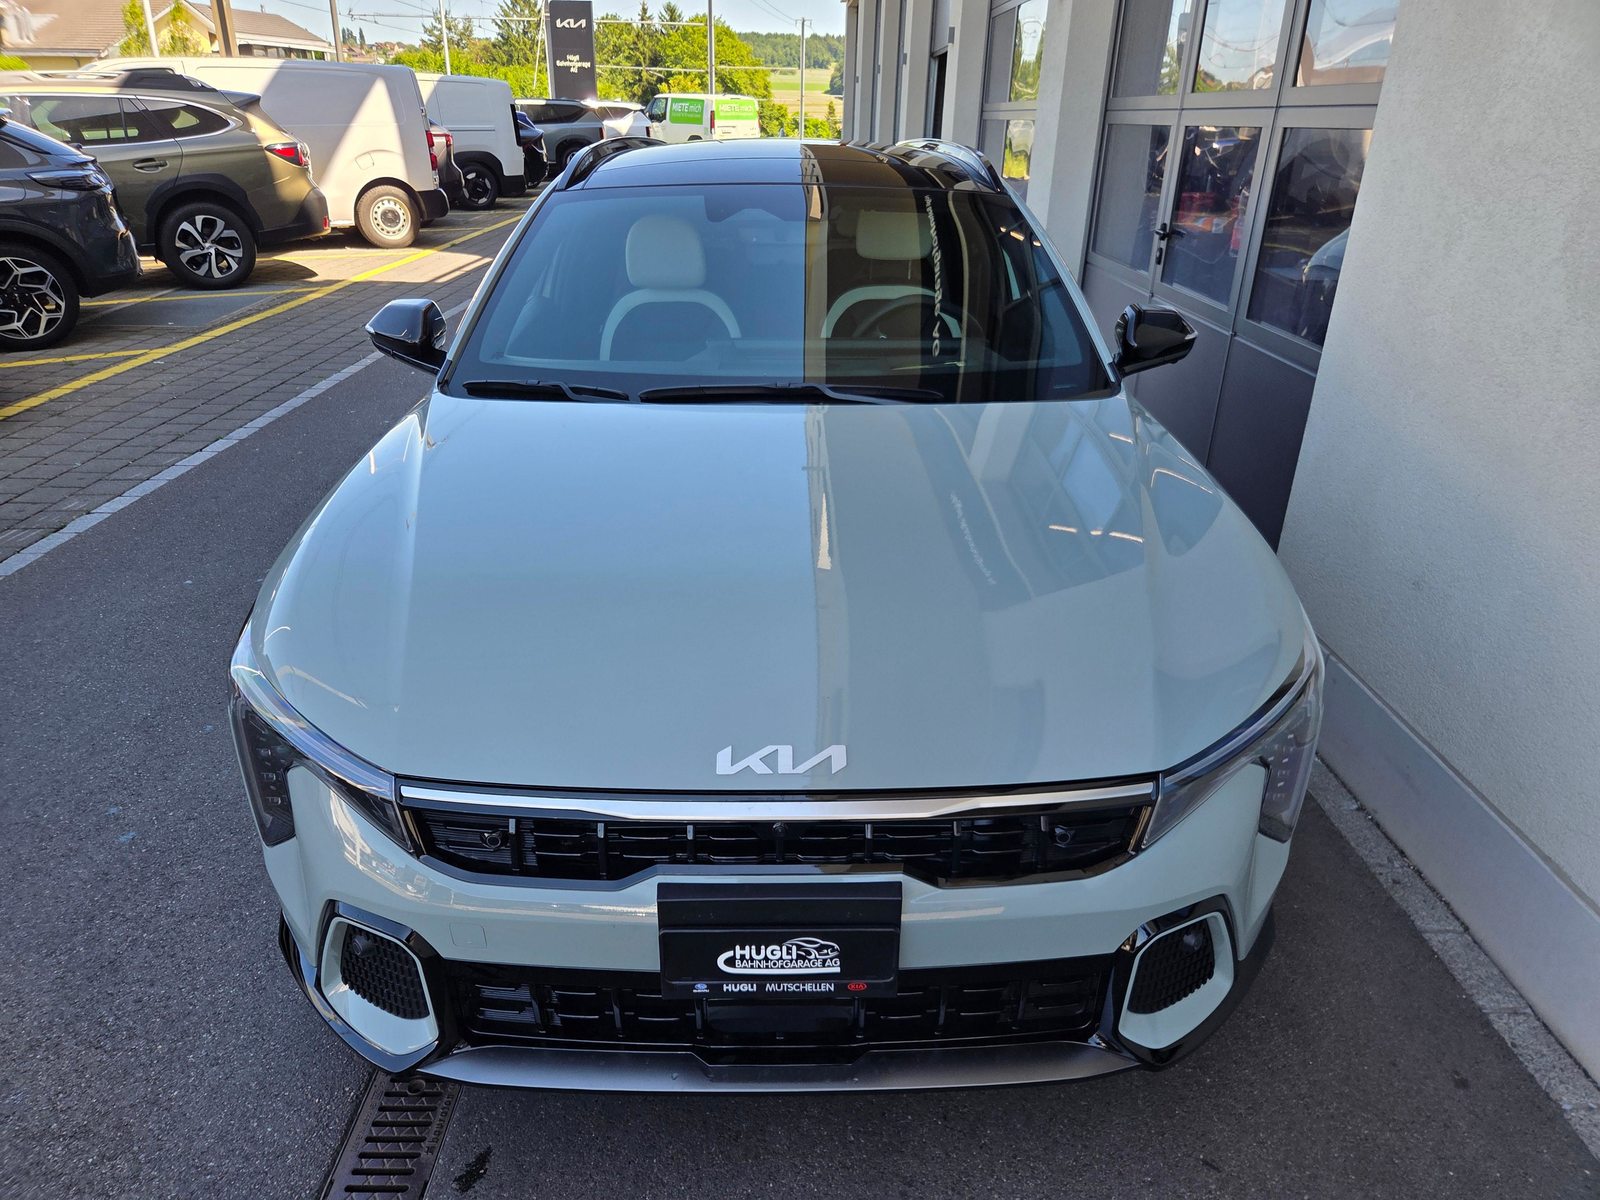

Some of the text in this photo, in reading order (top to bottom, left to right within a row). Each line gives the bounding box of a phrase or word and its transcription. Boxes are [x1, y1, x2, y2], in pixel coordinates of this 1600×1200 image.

[555, 18, 586, 29] KIA
[672, 102, 702, 113] MIETE mich
[716, 744, 847, 775] KIA
[735, 958, 840, 969] BAHNHOFGARAGE AG
[765, 983, 835, 992] MUTSCHELLEN
